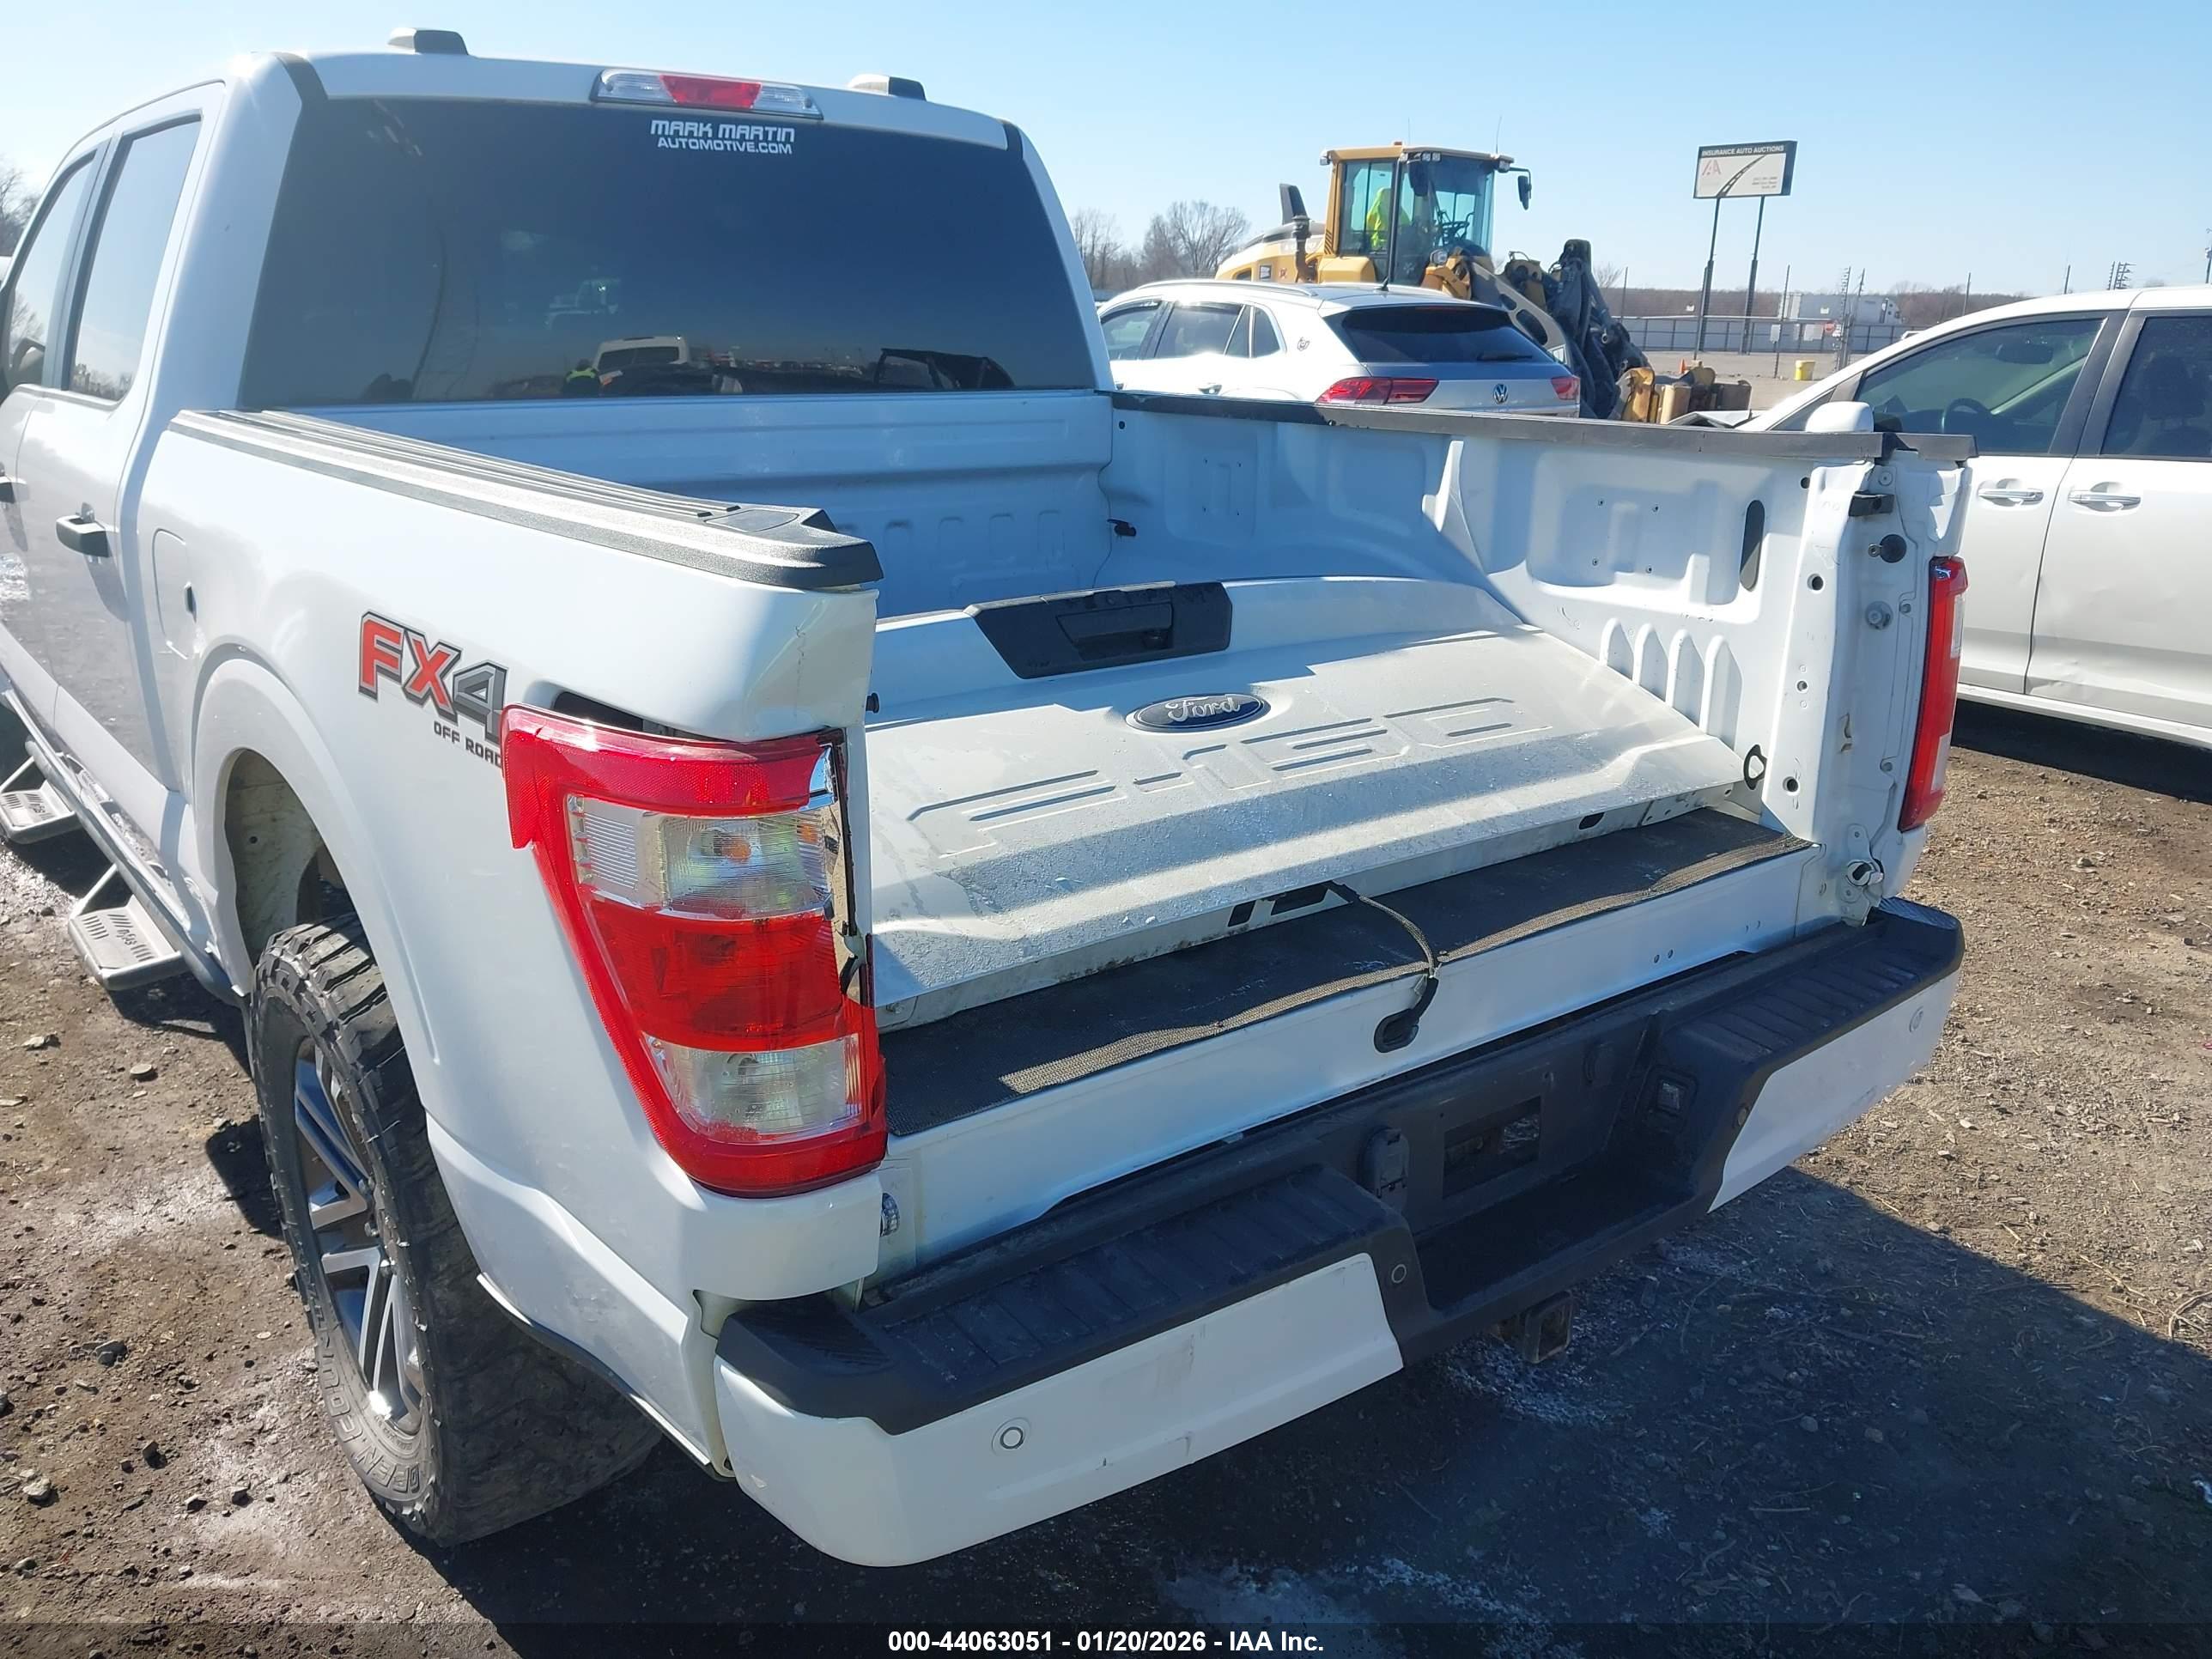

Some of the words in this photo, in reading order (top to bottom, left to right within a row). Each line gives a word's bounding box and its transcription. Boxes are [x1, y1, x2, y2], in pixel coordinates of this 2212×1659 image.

[650, 119, 714, 138] MARK
[718, 124, 795, 143] MARTIN
[657, 137, 793, 155] AUTOMOTIVE.COM
[1701, 149, 1735, 157] INSURANCE
[358, 611, 508, 747] FX4
[1164, 696, 1242, 722] Ford
[434, 720, 460, 744] OFF
